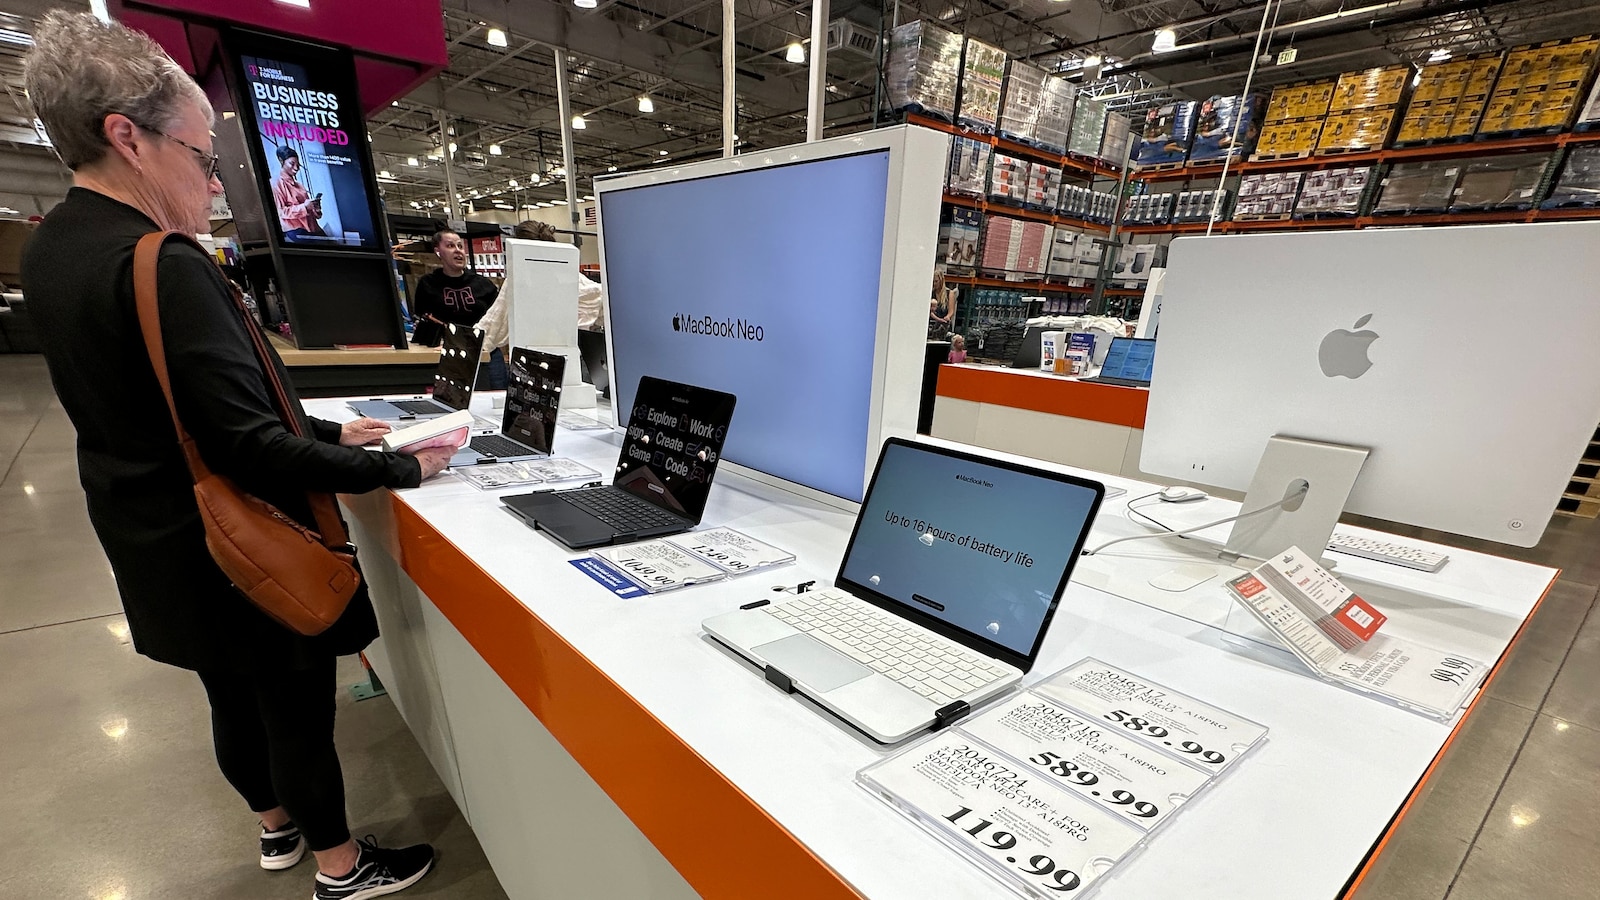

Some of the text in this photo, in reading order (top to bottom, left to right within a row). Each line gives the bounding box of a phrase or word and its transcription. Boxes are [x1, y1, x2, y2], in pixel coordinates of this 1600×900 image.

[1280, 50, 1294, 63] EXIT
[252, 82, 338, 110] BUSINESS
[258, 101, 340, 128] BENEFITS
[263, 120, 348, 146] INCLUDED
[682, 314, 764, 341] MacBook Neo
[530, 408, 543, 421] Code
[647, 408, 714, 439] Explore Work
[656, 431, 683, 452] Create
[629, 444, 688, 476] Game Code
[960, 474, 981, 485] MacBook
[885, 510, 1034, 568] Up to 16 hours of battery life
[618, 558, 675, 585] 1049.99
[1099, 669, 1167, 699] 2046717
[1429, 657, 1474, 686] 99.99
[1133, 694, 1174, 712] INDIGO
[1031, 702, 1104, 738] 2046716
[1019, 703, 1072, 730] MACBOOK
[1074, 730, 1099, 742] NEO
[1119, 752, 1167, 775] A18PRO
[1065, 732, 1108, 754] SILVER
[1103, 710, 1226, 765] 589.99
[952, 744, 1031, 788] 2046724
[932, 750, 990, 784] MACBOOK
[988, 782, 1016, 799] NEO
[1036, 810, 1089, 842] A18PRO
[940, 746, 1091, 833] 3-YEAR APPLECARE+ FOR
[1028, 752, 1159, 818] 589.99
[942, 805, 1081, 892] 119.99
